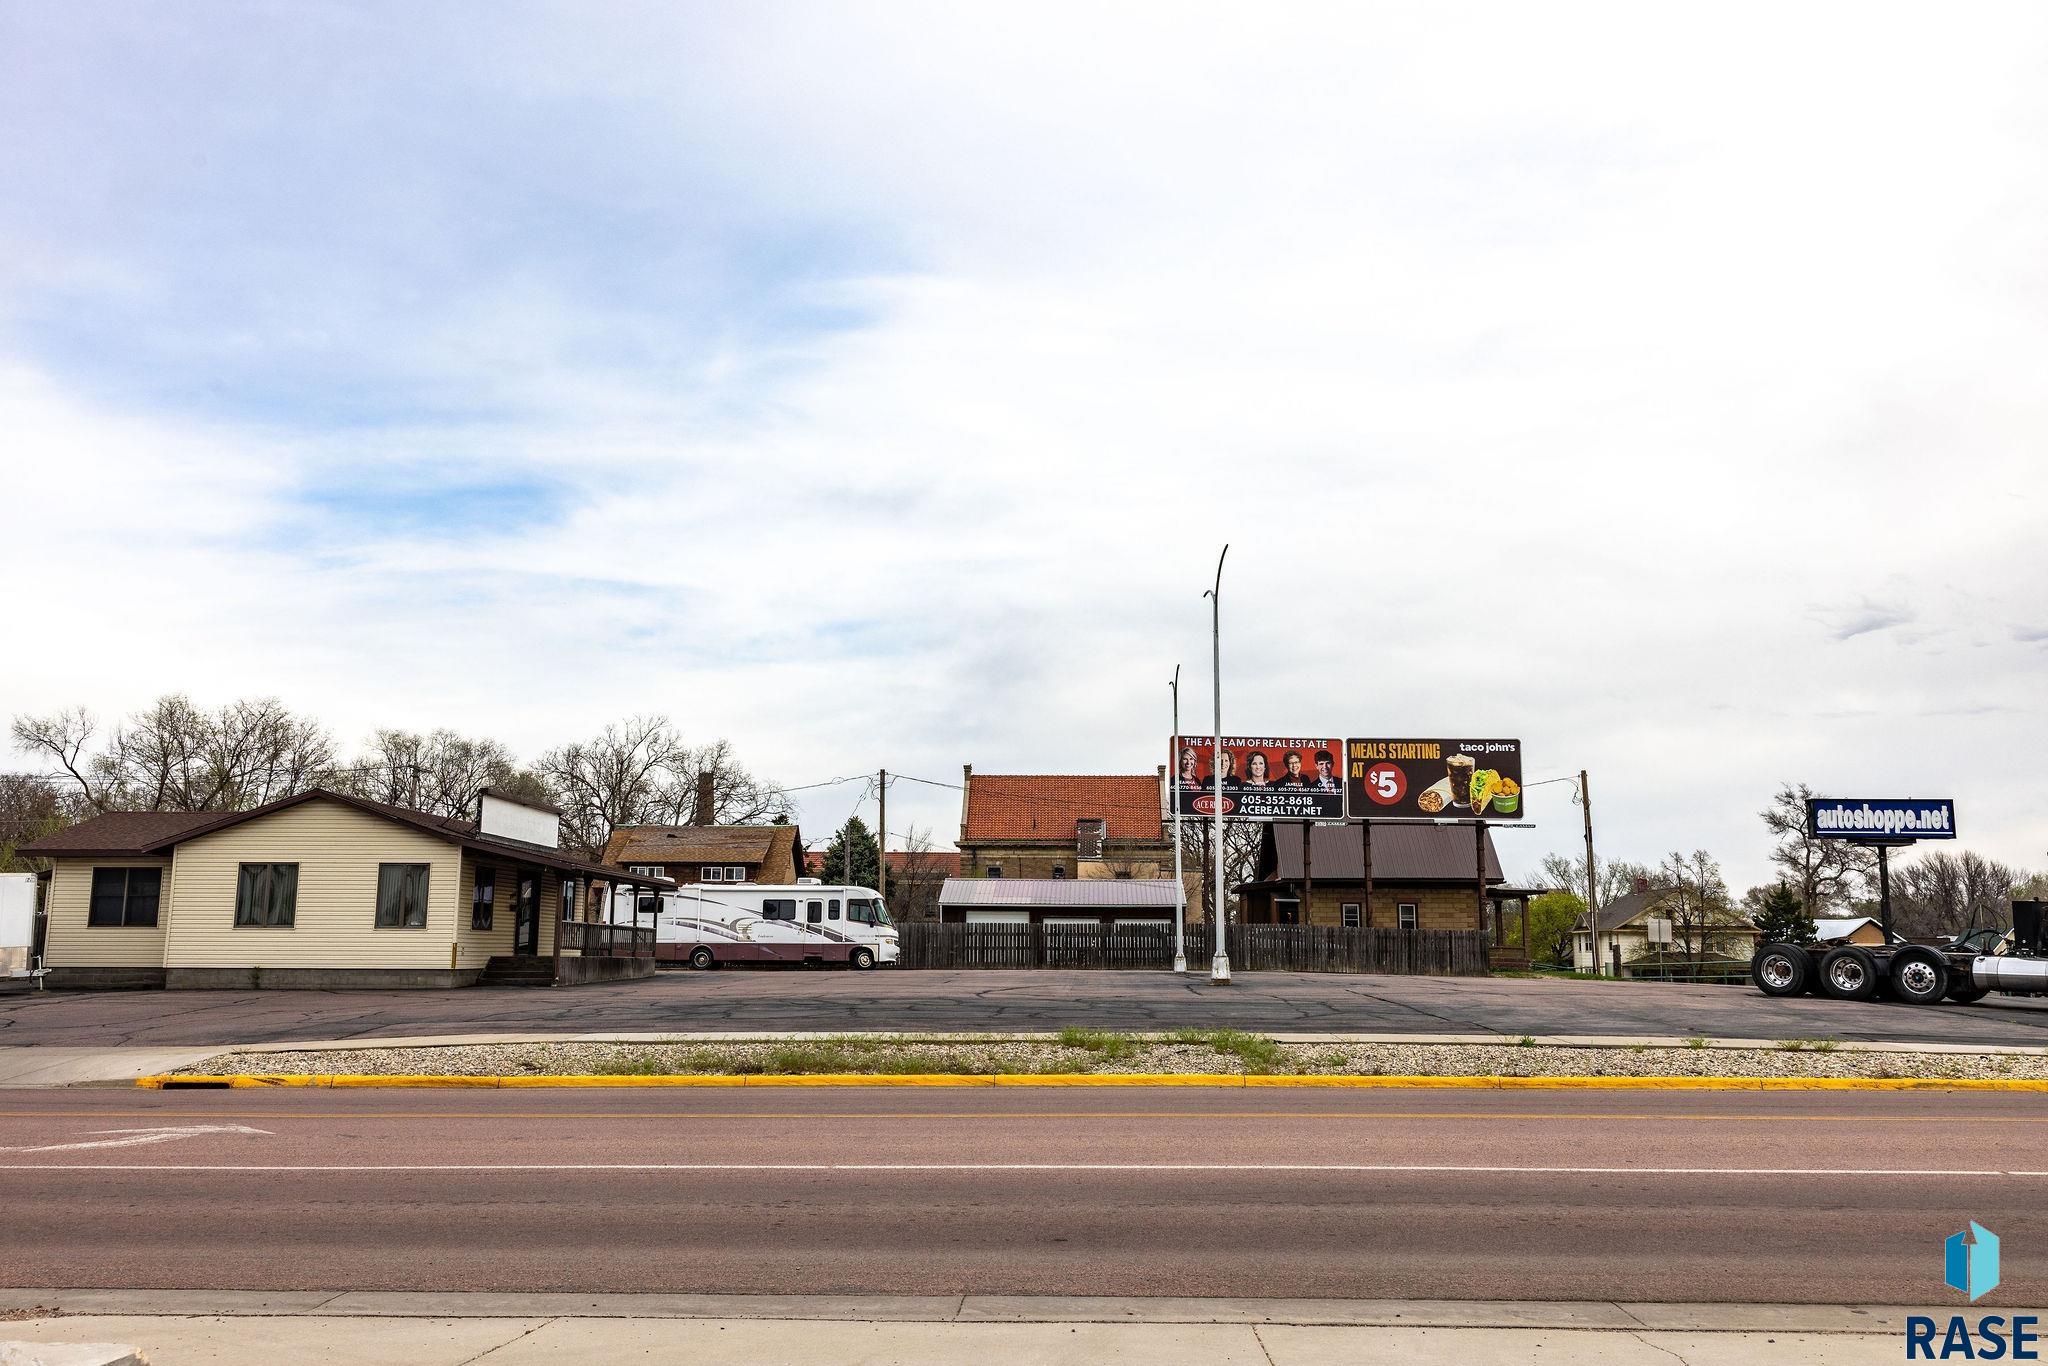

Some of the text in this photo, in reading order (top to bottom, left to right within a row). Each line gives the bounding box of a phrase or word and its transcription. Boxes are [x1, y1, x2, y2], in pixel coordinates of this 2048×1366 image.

[1184, 738, 1203, 746] THE
[1247, 738, 1260, 747] OF
[1262, 738, 1289, 748] REAL
[1289, 739, 1328, 749] ESTATE
[1459, 742, 1516, 754] taco john's
[1350, 742, 1440, 760] MEALS STARTING
[1351, 762, 1365, 778] AT
[1369, 771, 1398, 798] $5
[1196, 800, 1209, 809] ACE
[1241, 795, 1313, 806] 605-352-8618
[1239, 805, 1323, 816] ACEREALTY.NET
[1817, 803, 1950, 834] autoshoppe.net
